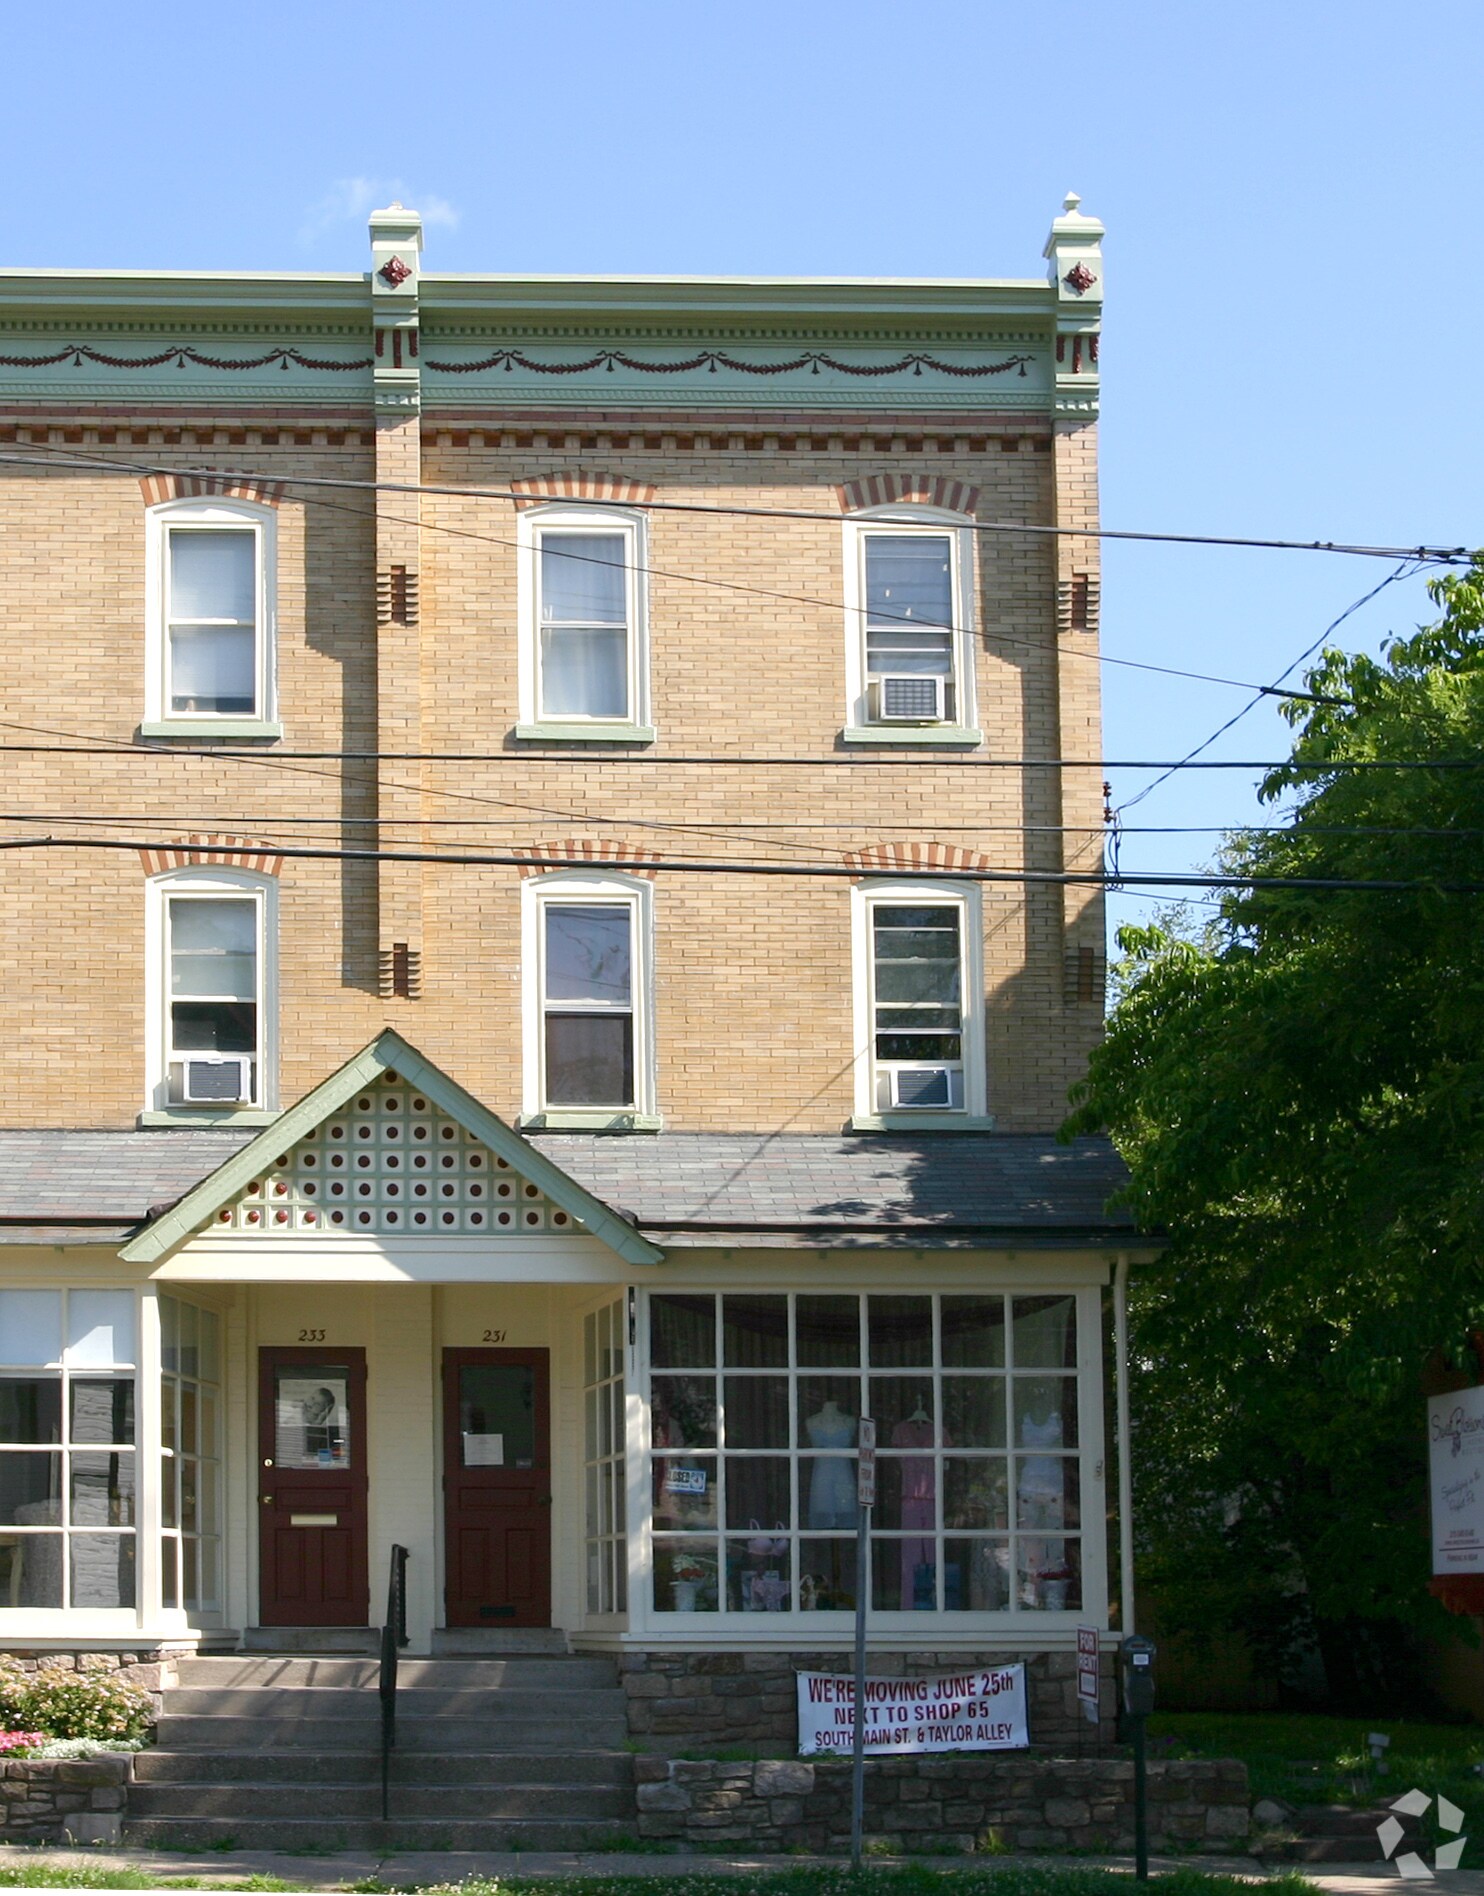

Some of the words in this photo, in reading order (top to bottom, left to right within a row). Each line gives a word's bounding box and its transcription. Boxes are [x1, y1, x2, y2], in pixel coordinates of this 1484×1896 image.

[298, 1329, 326, 1342] 233
[482, 1329, 507, 1342] 231
[1080, 1631, 1094, 1651] FOR
[1079, 1652, 1097, 1672] RENT
[808, 1677, 856, 1703] WE'RE
[863, 1680, 928, 1703] MOVING
[932, 1675, 977, 1700] JUNE
[981, 1671, 1013, 1696] 25th
[888, 1706, 908, 1722] TO
[914, 1702, 961, 1722] SHOP
[967, 1701, 989, 1718] 65
[815, 1731, 856, 1747] SOUTH
[862, 1728, 890, 1745] MAIN
[894, 1727, 911, 1745] ST.
[917, 1727, 925, 1743] &
[928, 1725, 973, 1743] TAYLOR
[976, 1723, 1013, 1741] ALLEY
